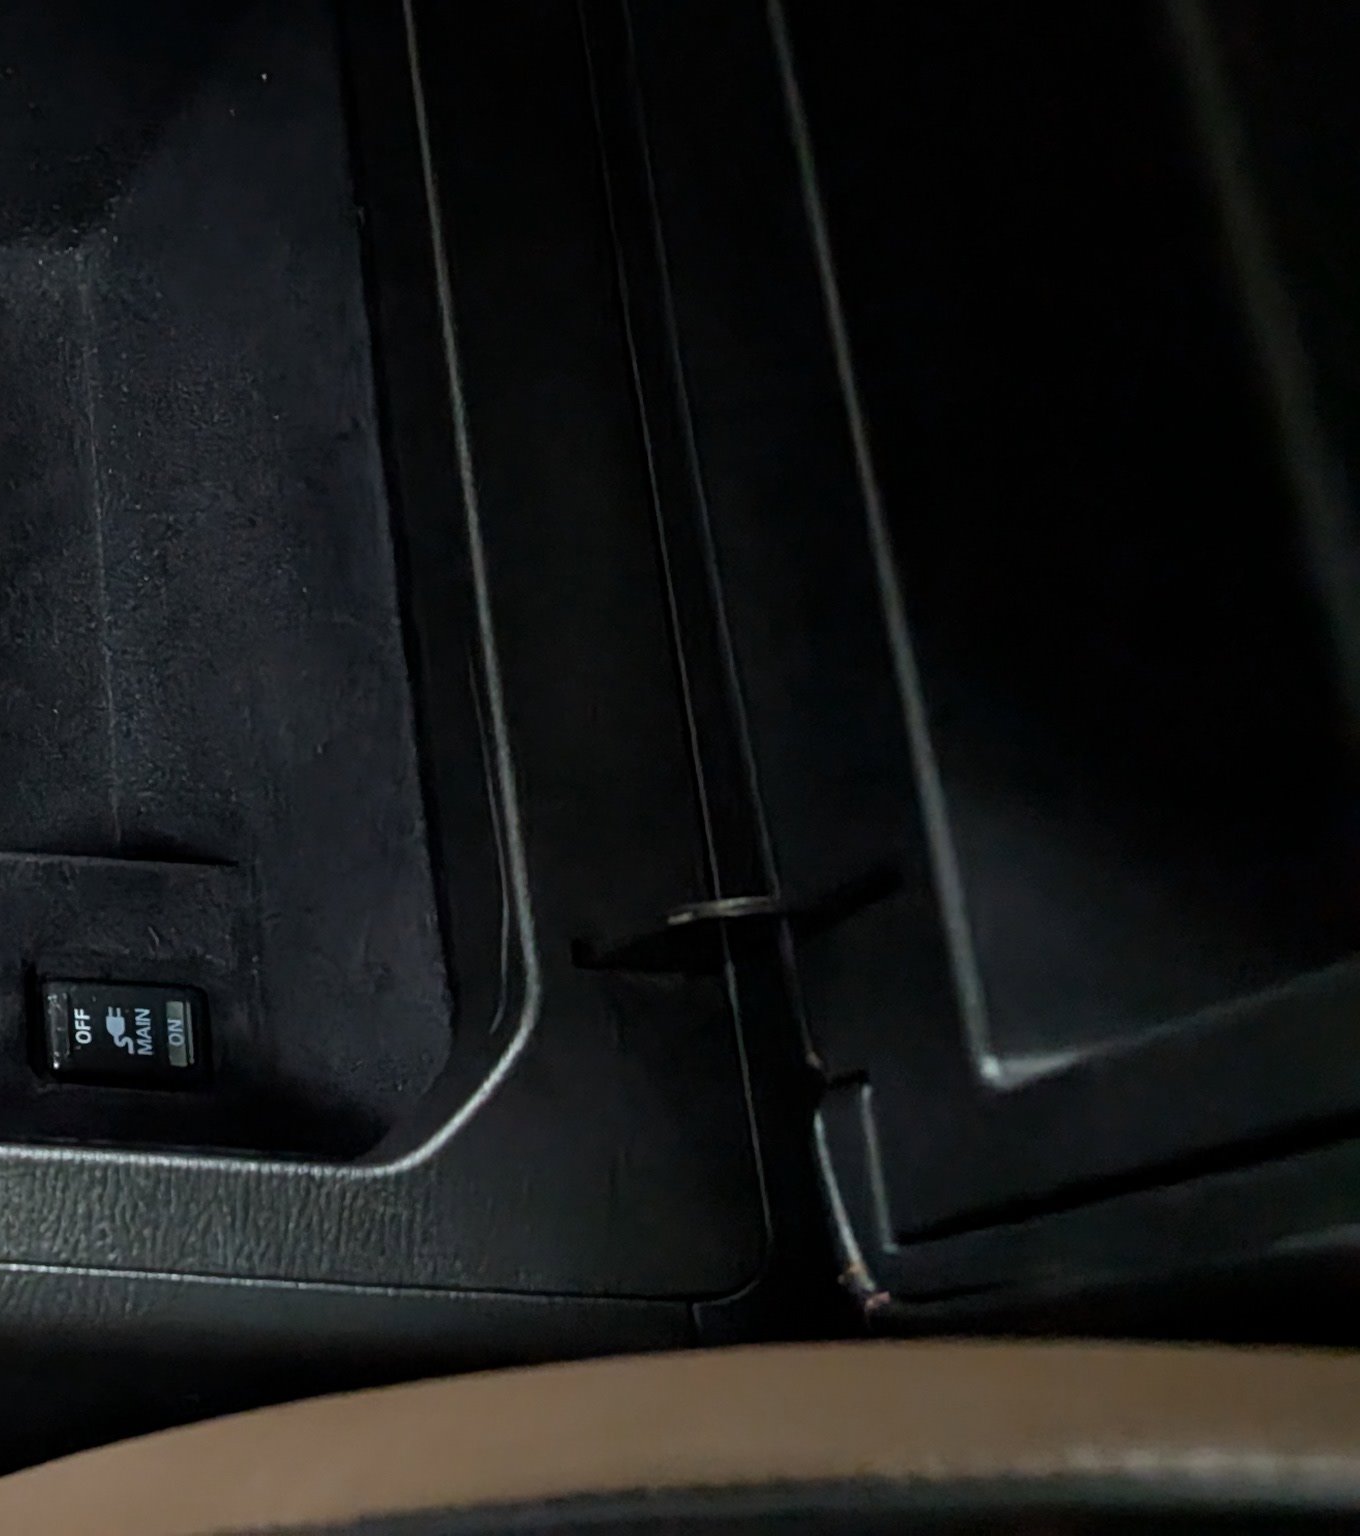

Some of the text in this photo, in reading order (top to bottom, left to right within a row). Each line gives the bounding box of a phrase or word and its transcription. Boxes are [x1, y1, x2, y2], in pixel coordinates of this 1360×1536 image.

[74, 1007, 93, 1045] OFF
[134, 1008, 156, 1056] MAIN
[166, 1018, 186, 1047] ON
